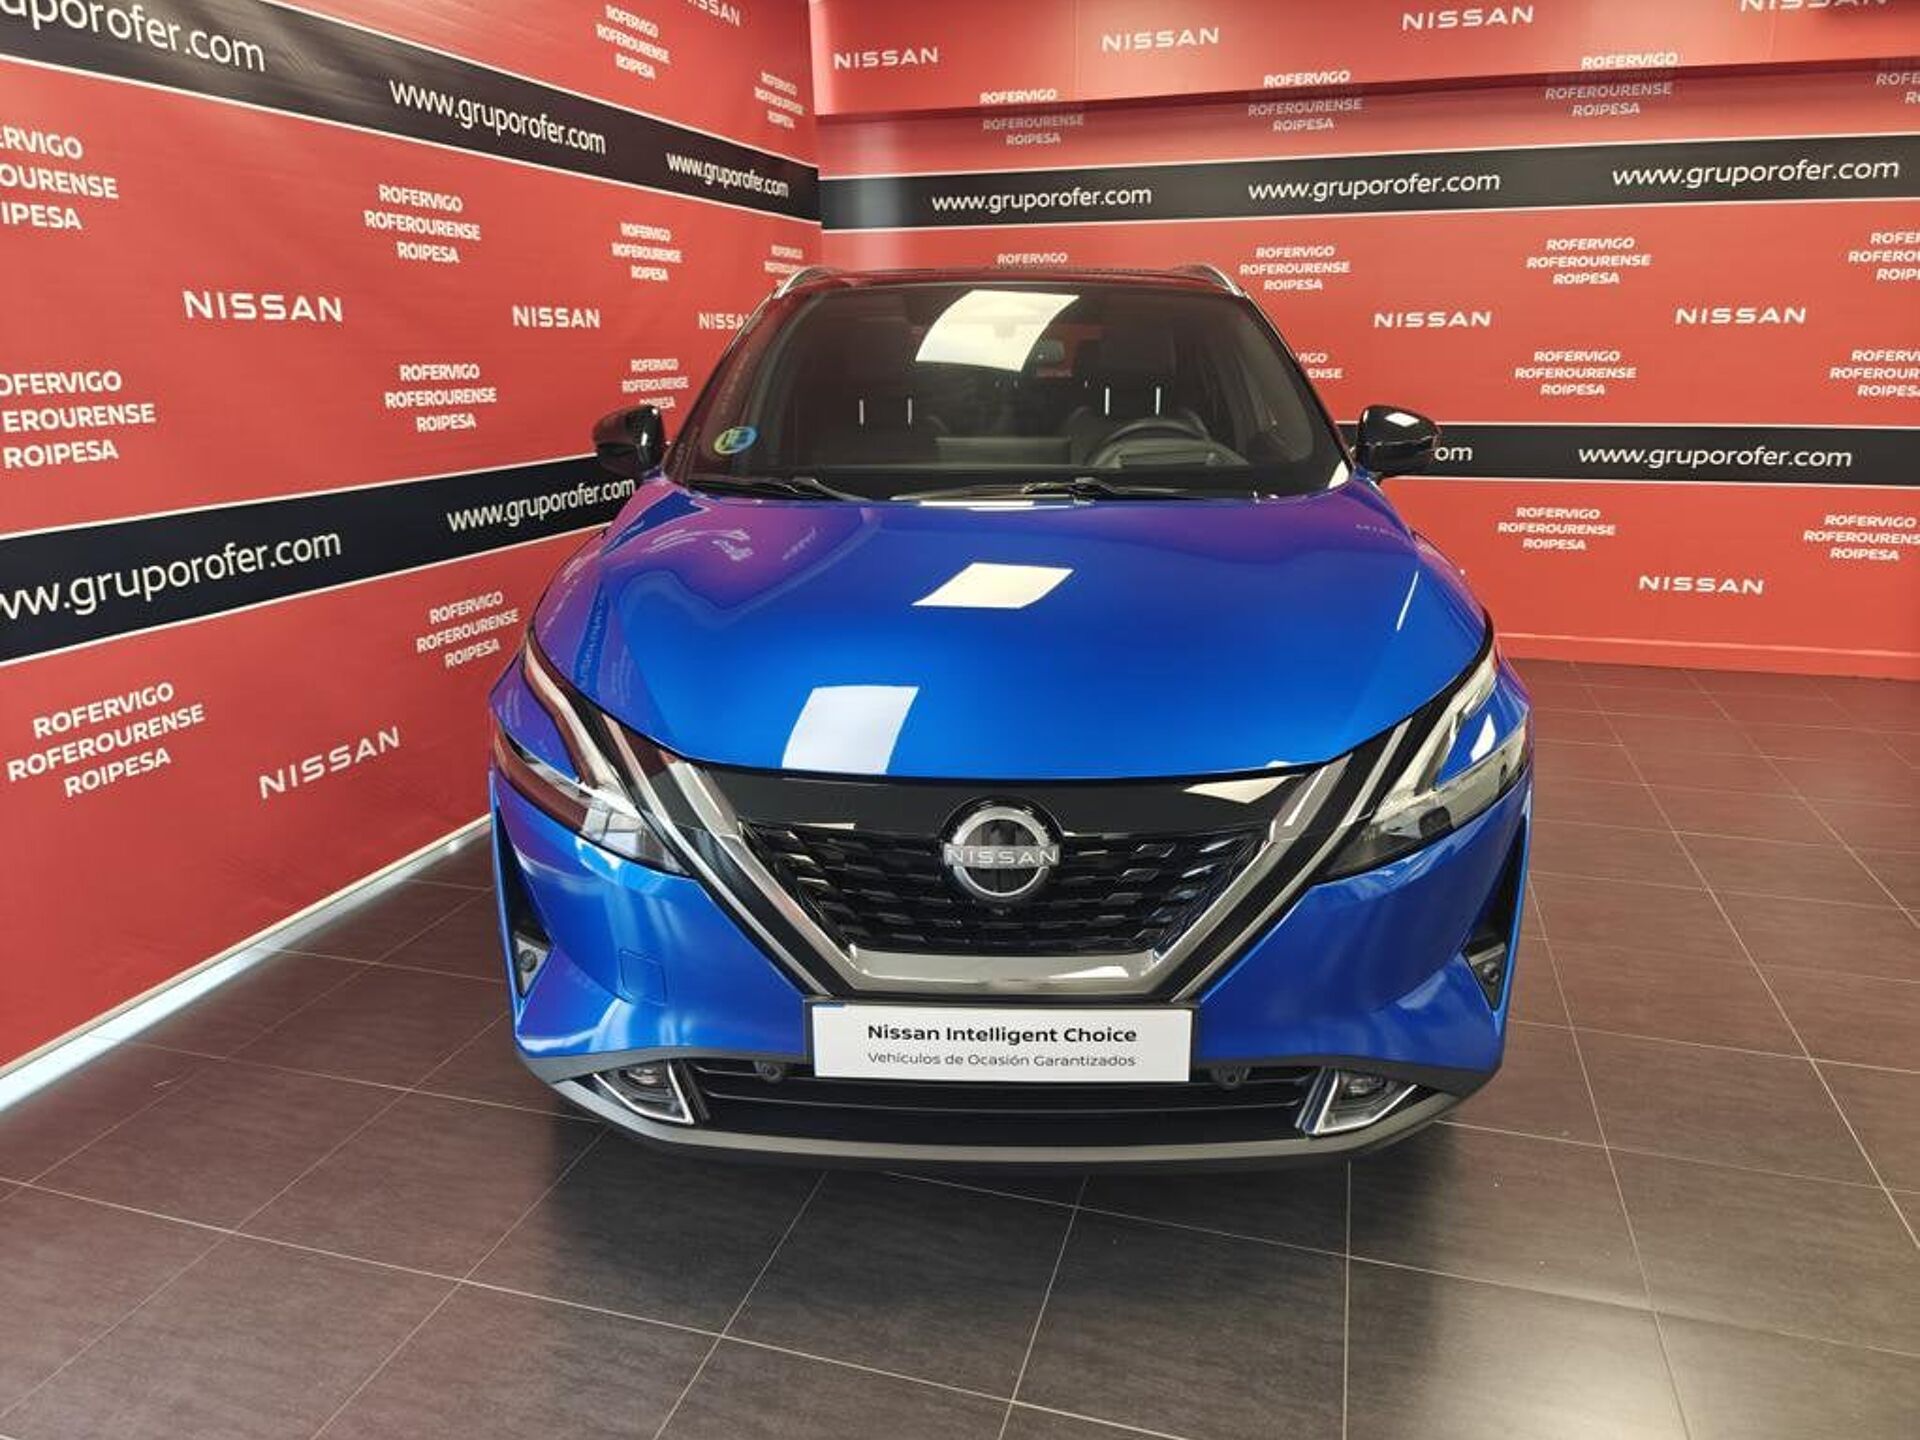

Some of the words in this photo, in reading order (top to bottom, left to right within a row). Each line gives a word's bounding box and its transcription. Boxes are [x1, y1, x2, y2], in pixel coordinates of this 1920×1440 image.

[1402, 6, 1534, 30] NISSAN
[1102, 28, 1220, 52] NISSAN
[834, 47, 939, 70] NISSAN
[1581, 52, 1678, 70] ROFERVIGO
[1263, 71, 1349, 88] ROFERVIGO
[979, 88, 1057, 104] ROFERVIGO
[1545, 82, 1672, 100] ROFEROURENSE
[388, 79, 606, 155] www.gruporofer.com
[1248, 98, 1362, 117] ROFEROURENSE
[1572, 103, 1640, 116] ROIPESA
[1273, 117, 1334, 132] ROIPESA
[1006, 133, 1060, 146] ROIPESA
[665, 152, 788, 198] www.gruporofer.com
[1612, 158, 1899, 189] www.gruporofer.com
[1248, 171, 1500, 203] www.gruporofer.com
[379, 184, 463, 213] ROFERVIGO
[932, 186, 1152, 214] www.gruporofer.com
[2, 202, 82, 230] IPESA
[363, 210, 481, 241] ROFEROURENSE
[396, 241, 460, 264] ROIPESA
[1256, 246, 1335, 258] ROFERVIGO
[1546, 237, 1635, 250] ROFERVIGO
[1239, 261, 1351, 275] ROFEROURENSE
[1526, 254, 1651, 268] ROFEROURENSE
[1264, 279, 1323, 290] ROIPESA
[1553, 272, 1620, 285] ROIPESA
[183, 290, 343, 322] NISSAN
[1675, 306, 1806, 325] NISSAN
[512, 305, 600, 329] NISSAN
[699, 313, 749, 330] NISSA
[1374, 310, 1491, 328] NISSAN
[1533, 351, 1620, 362] ROFERVIGO
[400, 364, 480, 381] ROFERVIGO
[1514, 367, 1637, 379] ROFEROURENSE
[384, 388, 497, 409] ROFEROURENSE
[1540, 384, 1605, 395] ROIPESA
[2, 403, 156, 433] EROURENSE
[416, 413, 476, 433] ROIPESA
[4, 439, 119, 469] ROIPESA
[1578, 447, 1852, 470] www.gruporofer.com
[447, 479, 635, 532] www.gruporofer.com
[1516, 507, 1600, 520] ROFERVIGO
[1498, 522, 1616, 536] ROFEROURENSE
[1824, 514, 1917, 528] ROFERVIGO
[1523, 538, 1586, 550] ROIPESA
[1829, 547, 1899, 560] ROIPESA
[1638, 576, 1764, 595] NISSAN
[429, 591, 503, 625] ROFERVIGO
[417, 608, 519, 653] ROFEROURENSE
[444, 639, 500, 669] ROIPESA
[33, 682, 174, 739] ROFERVIGO
[7, 704, 205, 782] ROFEROURENSE
[259, 726, 400, 799] NISSAN
[64, 747, 171, 798] ROIPESA
[946, 848, 1057, 865] NISSAN
[868, 1025, 939, 1041] Nissan
[946, 1027, 1058, 1046] Intelligent
[1063, 1027, 1138, 1042] Choice
[868, 1052, 941, 1065] Vehículos
[945, 1053, 964, 1066] de
[967, 1053, 1030, 1066] Ocasión
[1033, 1055, 1136, 1067] Garantizados
